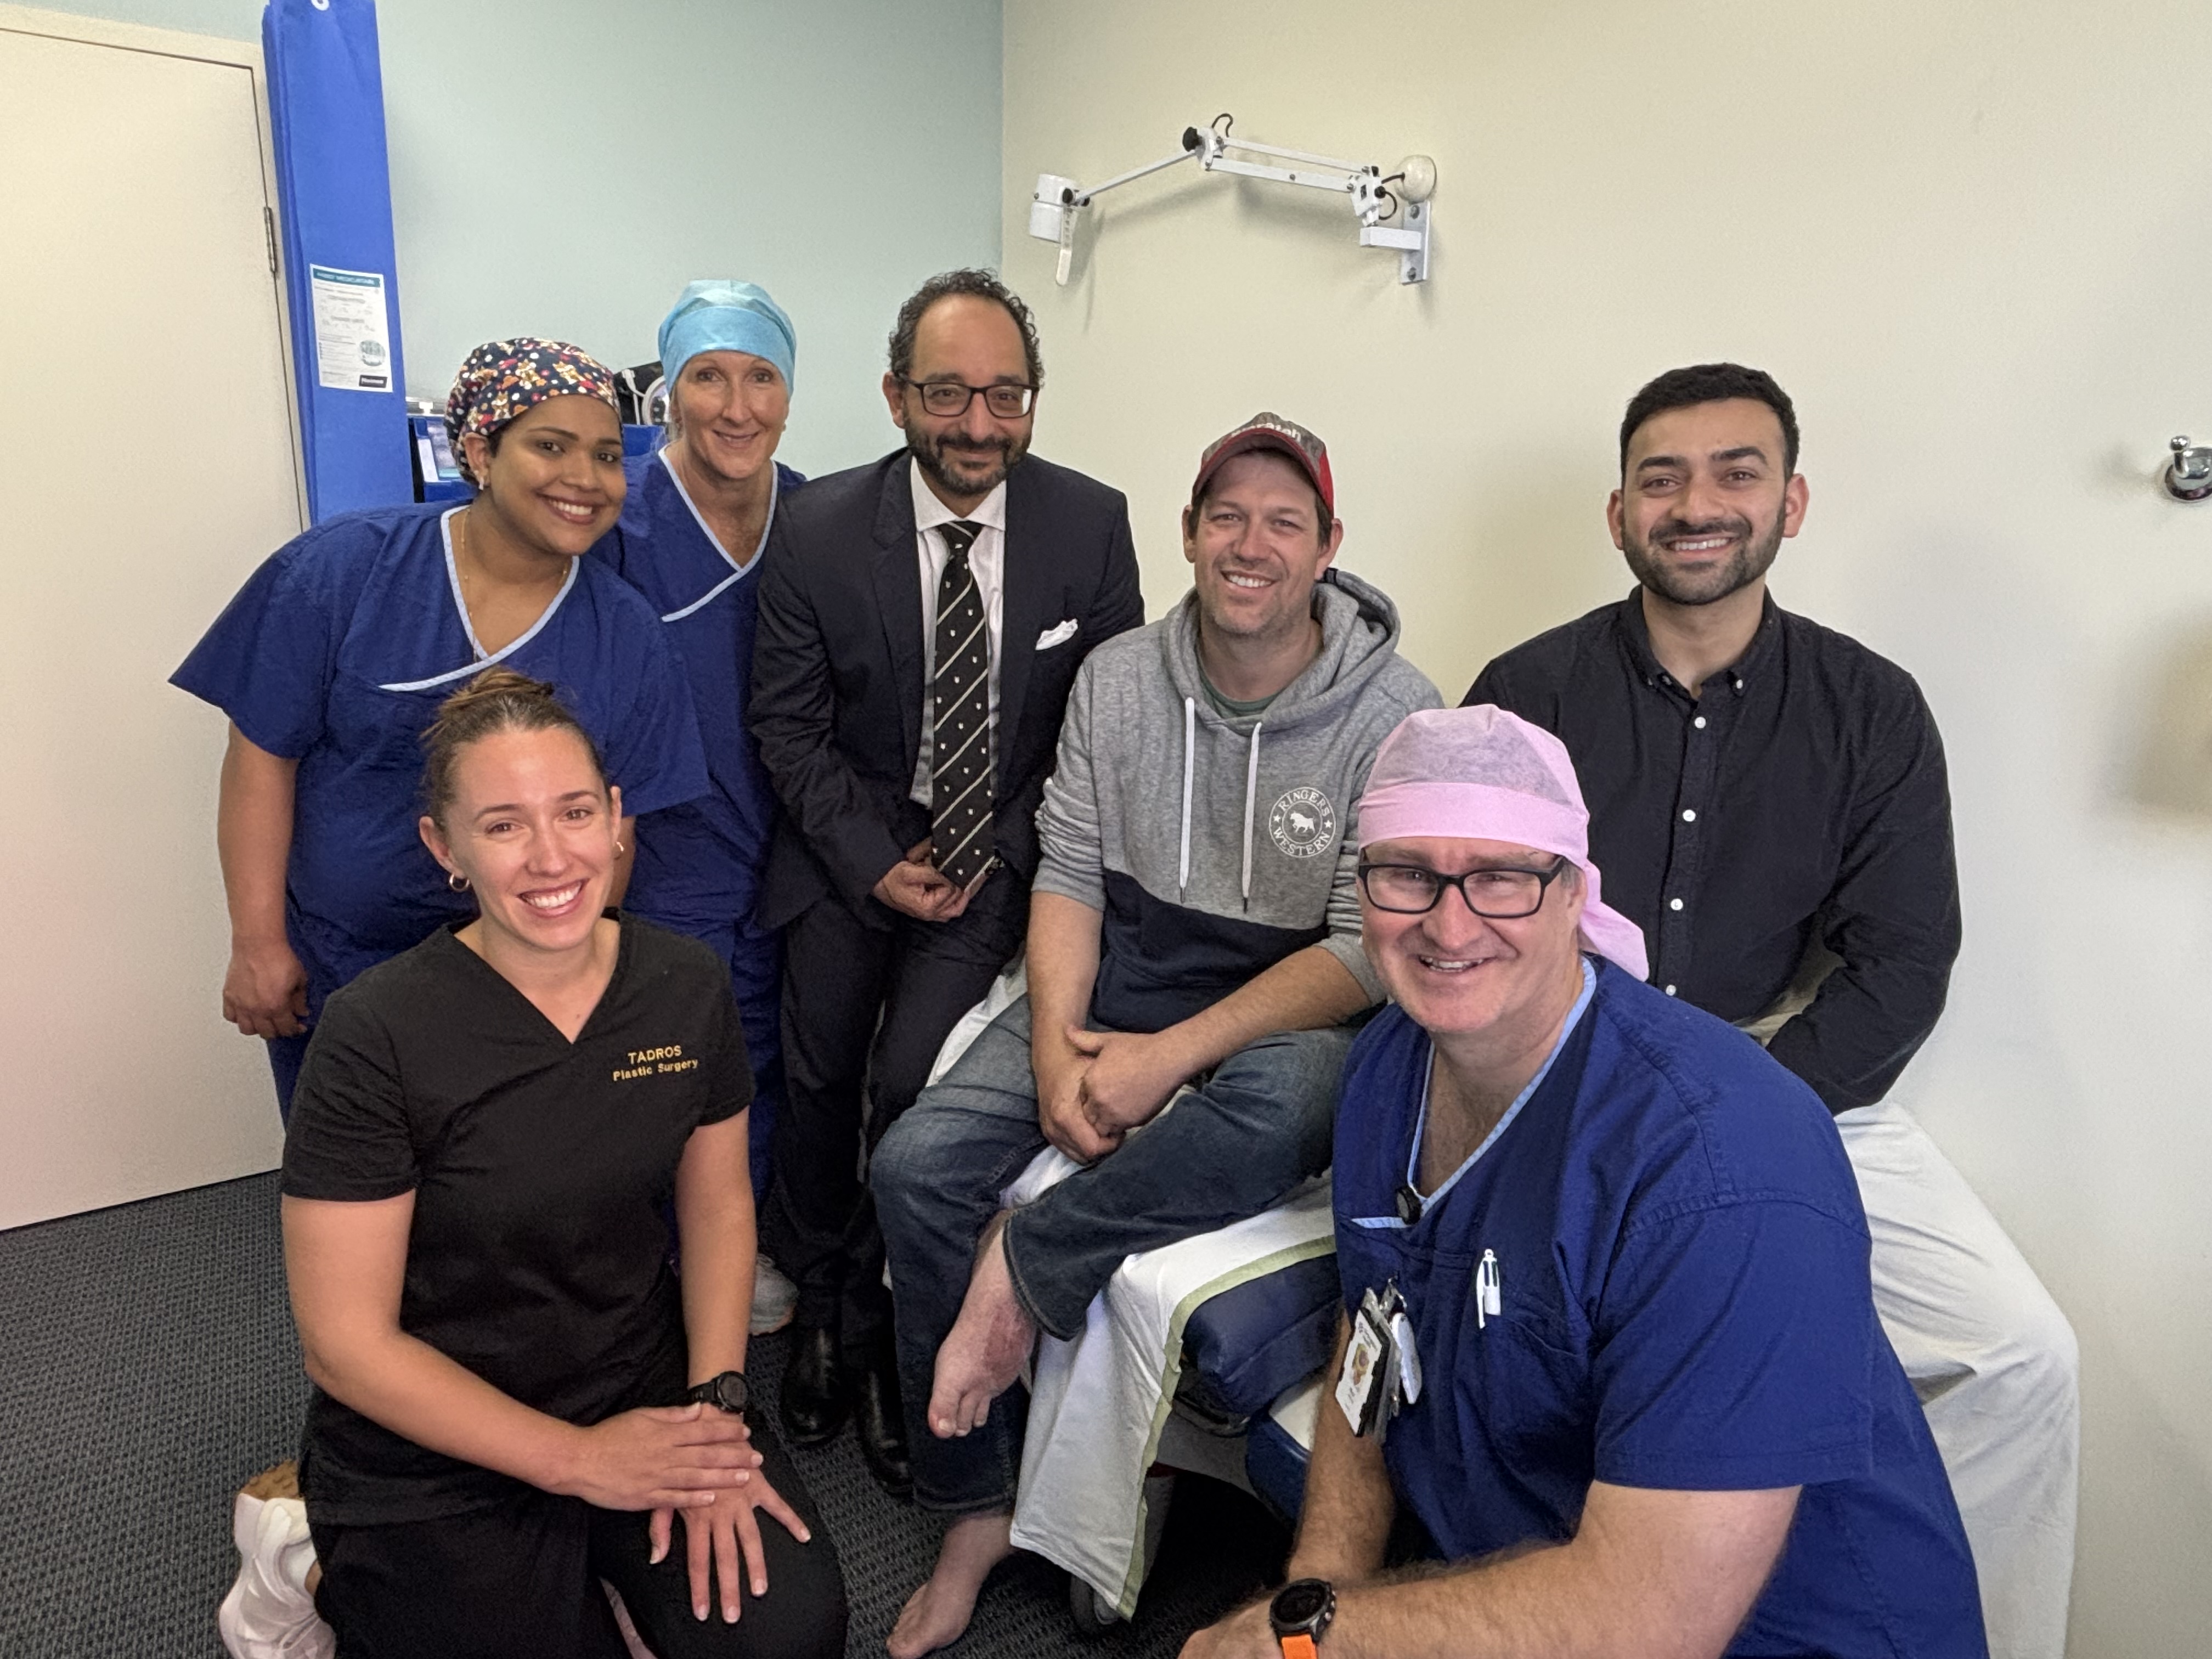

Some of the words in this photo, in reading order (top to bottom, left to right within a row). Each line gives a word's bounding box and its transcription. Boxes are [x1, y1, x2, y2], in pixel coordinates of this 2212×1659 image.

[1278, 789, 1330, 816] RINGERS
[1273, 826, 1330, 856] WESTERN
[628, 1045, 682, 1064] TADROS
[612, 1066, 653, 1082] Plastic
[657, 1059, 698, 1073] Surgery
